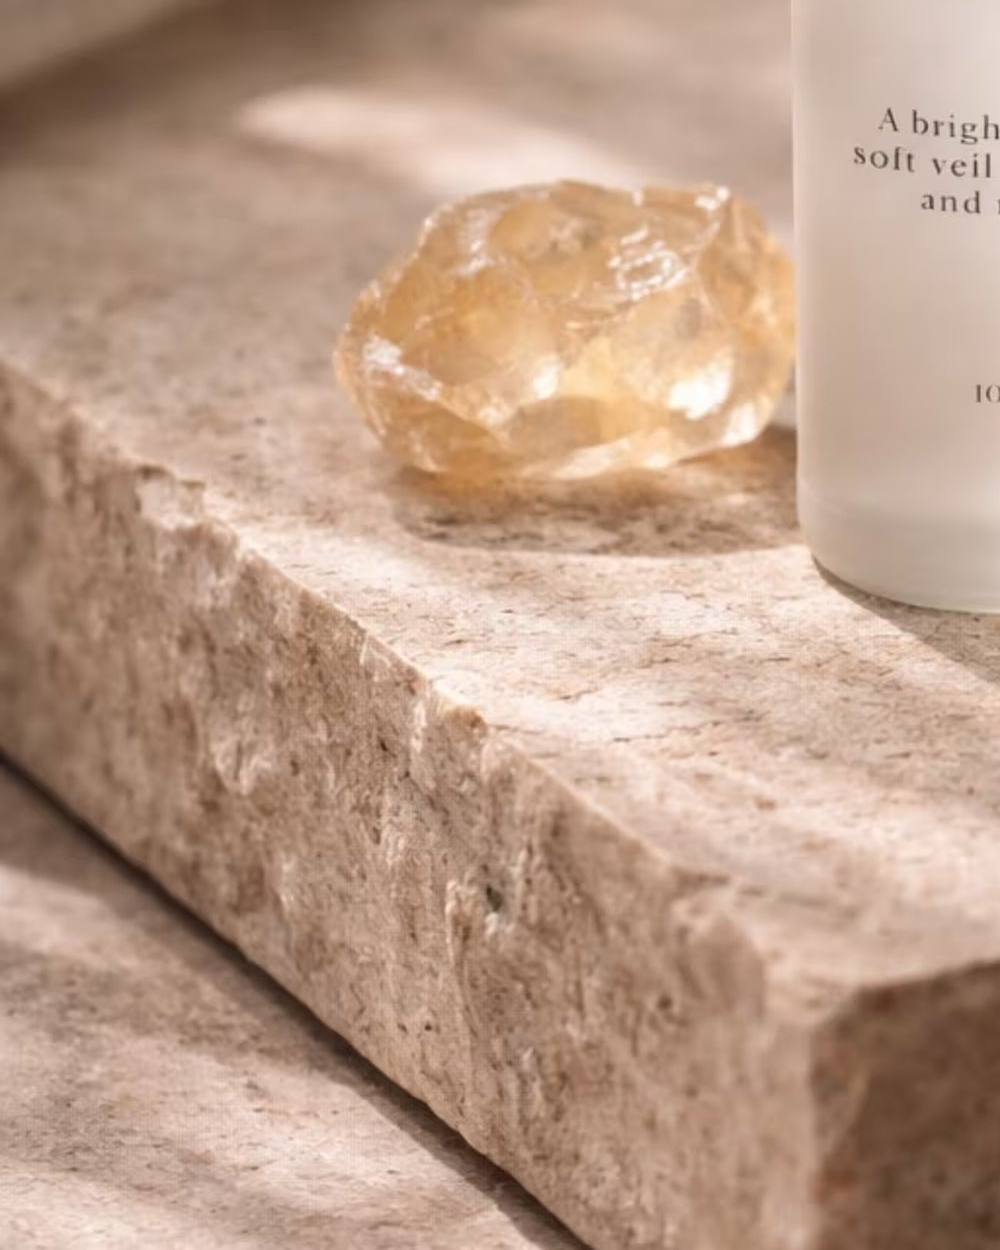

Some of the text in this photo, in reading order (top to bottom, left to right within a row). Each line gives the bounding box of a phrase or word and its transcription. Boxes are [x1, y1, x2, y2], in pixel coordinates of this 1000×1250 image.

[878, 107, 899, 132] A
[853, 146, 915, 172] soft
[932, 153, 992, 178] veil
[921, 191, 982, 215] and
